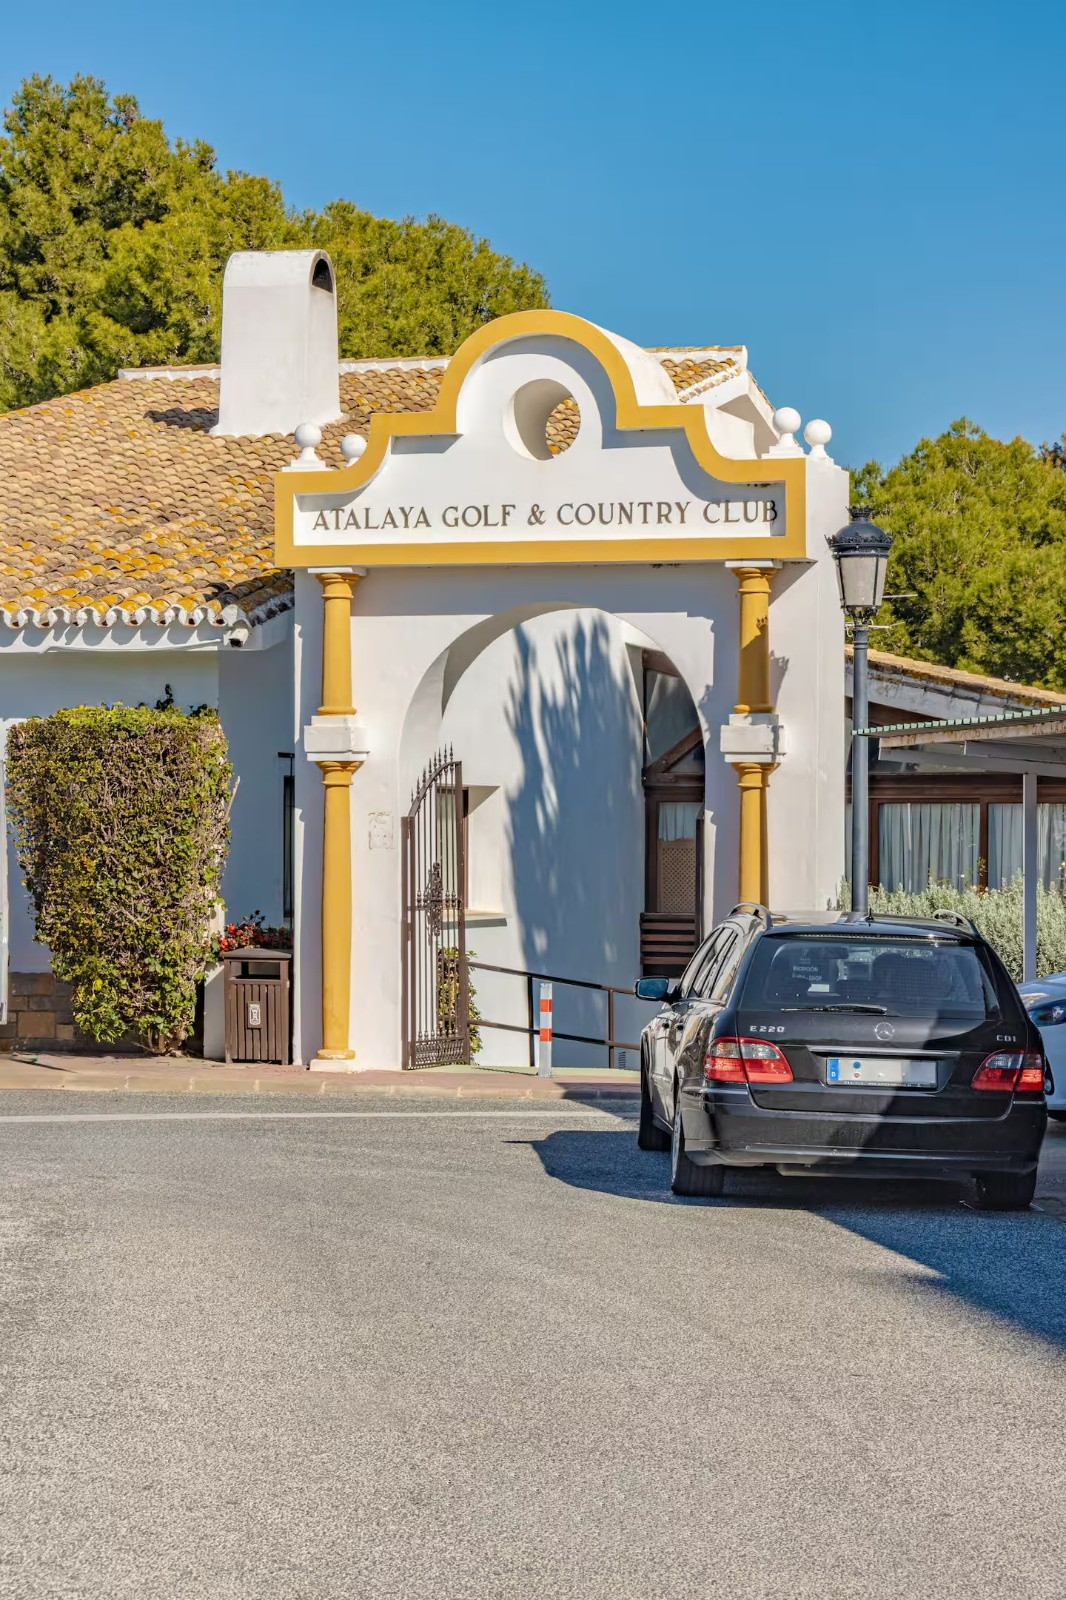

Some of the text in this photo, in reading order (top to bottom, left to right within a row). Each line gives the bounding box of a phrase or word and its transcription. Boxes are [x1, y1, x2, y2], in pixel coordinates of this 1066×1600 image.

[312, 500, 778, 530] ATALAYA GOLF & COUNTRY CLUB
[996, 1034, 1017, 1042] CDI
